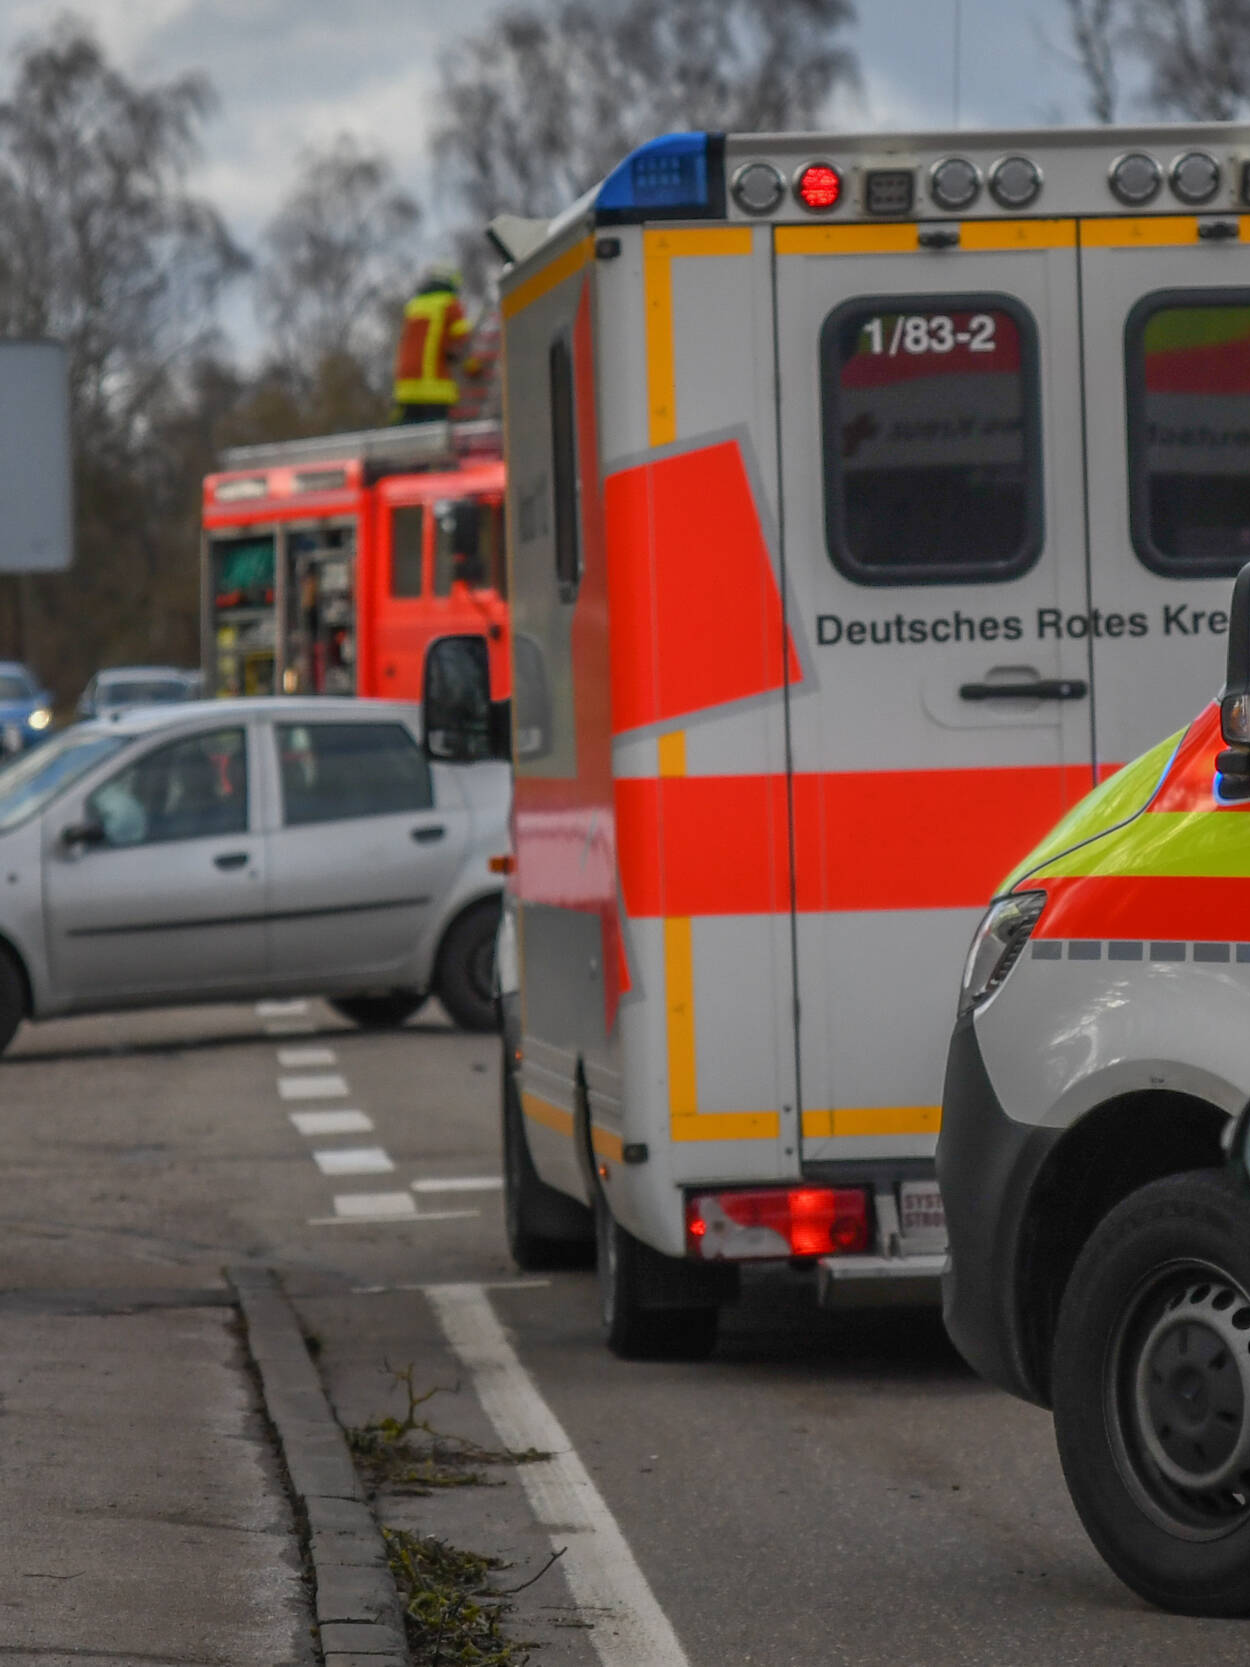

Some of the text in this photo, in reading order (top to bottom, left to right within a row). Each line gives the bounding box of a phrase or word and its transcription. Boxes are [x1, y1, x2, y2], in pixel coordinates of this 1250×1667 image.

[863, 314, 996, 356] 1/83-2
[815, 603, 1228, 646] Deutsches Rotes Kre
